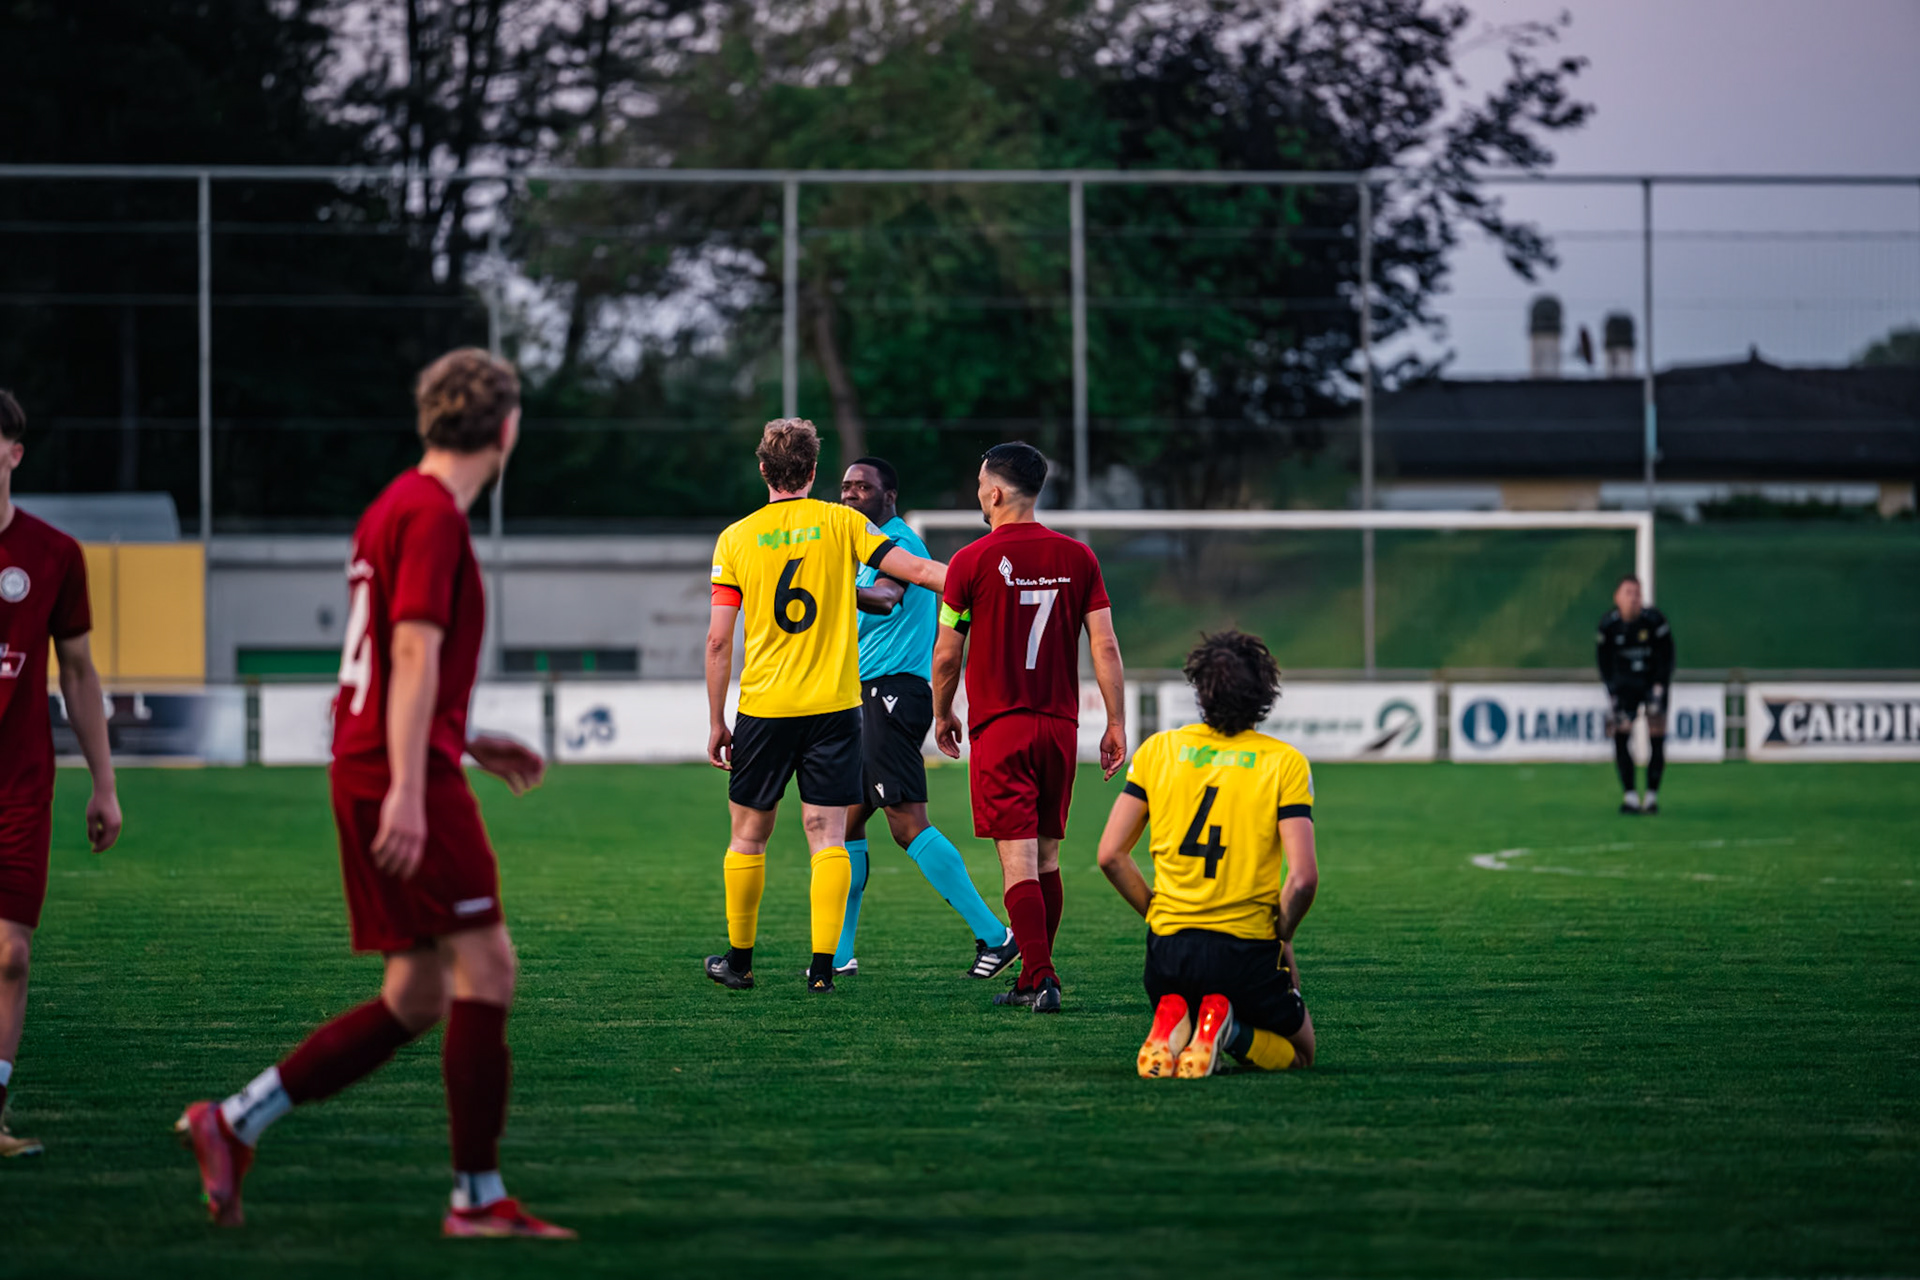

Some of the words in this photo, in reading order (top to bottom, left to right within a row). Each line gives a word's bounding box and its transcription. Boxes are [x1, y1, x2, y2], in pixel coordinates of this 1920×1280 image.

[774, 557, 818, 634] 6
[1020, 589, 1059, 670] 7
[1178, 785, 1227, 879] 4
